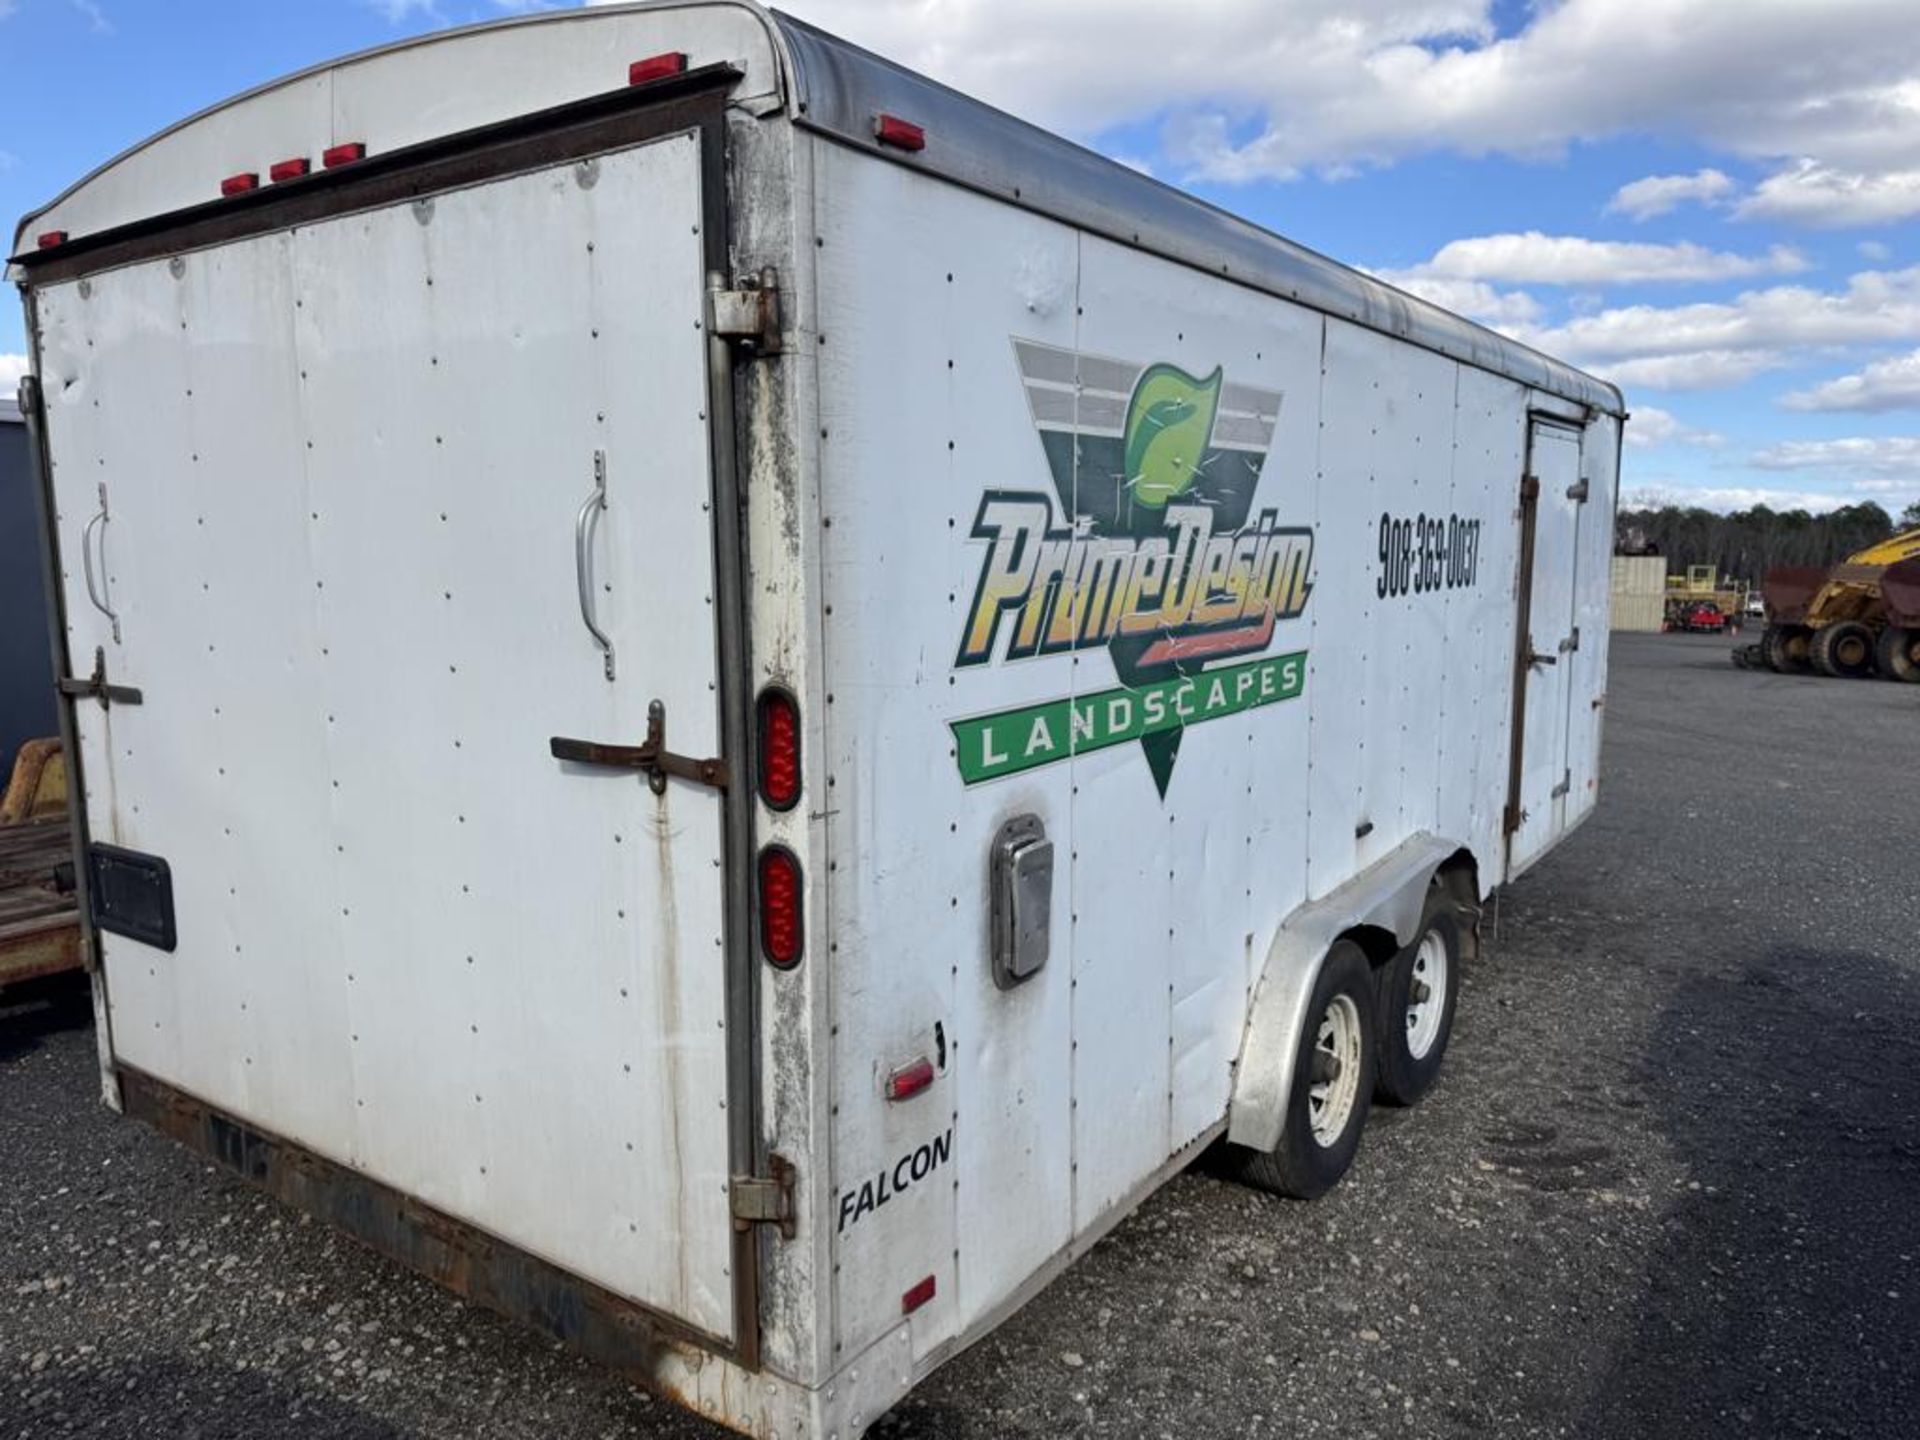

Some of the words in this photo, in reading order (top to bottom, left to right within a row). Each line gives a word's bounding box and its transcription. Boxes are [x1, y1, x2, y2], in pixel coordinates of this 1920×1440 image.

[1378, 512, 1480, 599] 908-369-0037
[982, 659, 1297, 767] LANDSCAPES
[838, 1129, 951, 1233] FALCON
